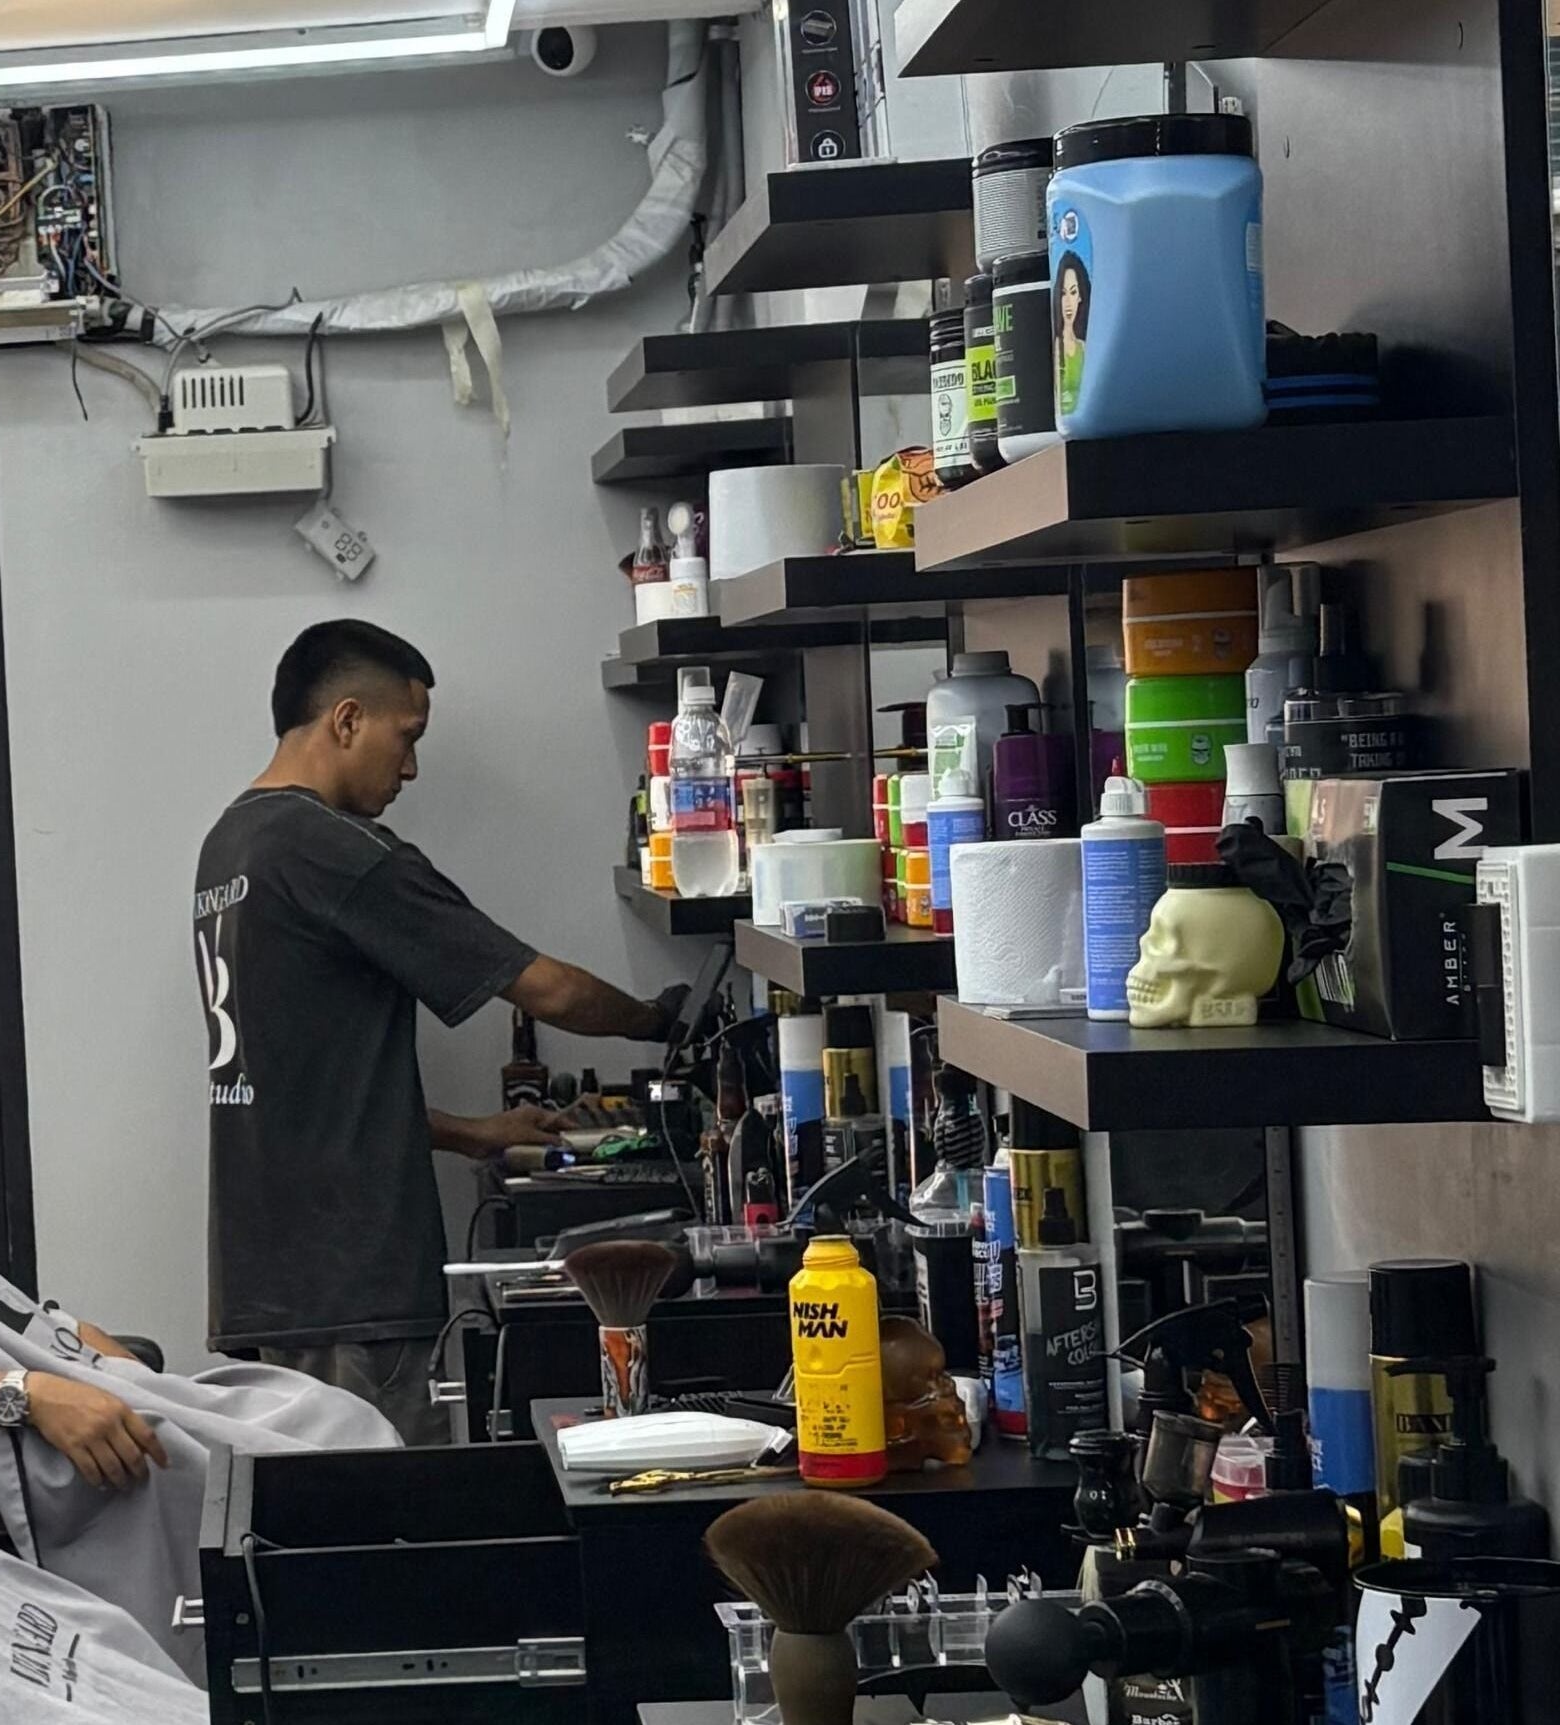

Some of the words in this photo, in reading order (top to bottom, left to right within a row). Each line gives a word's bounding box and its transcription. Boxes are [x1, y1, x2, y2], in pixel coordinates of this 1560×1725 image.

[1008, 810, 1057, 827] CLASS
[1443, 921, 1460, 1006] AMBER
[793, 1302, 839, 1320] NISH
[798, 1320, 848, 1339] MAN
